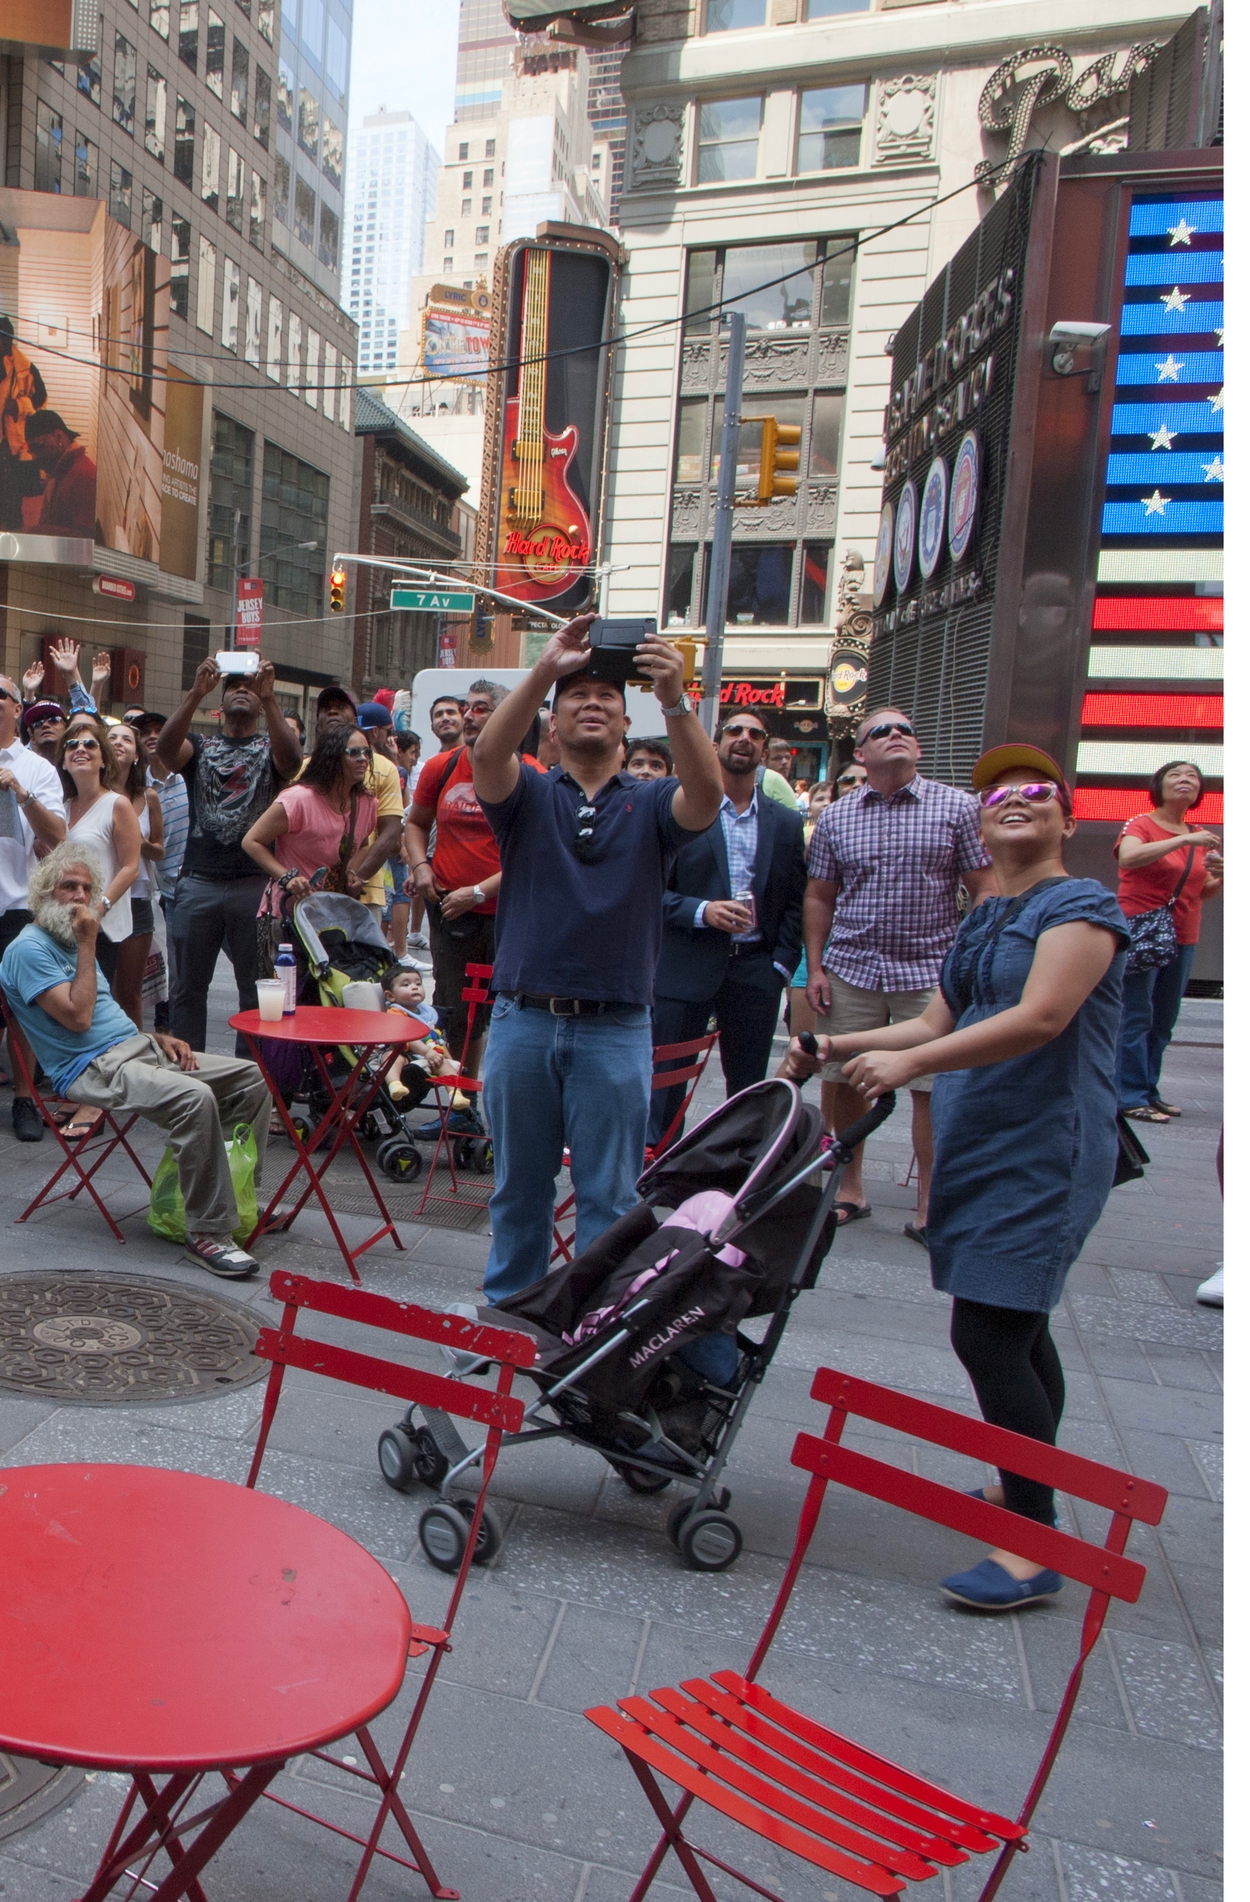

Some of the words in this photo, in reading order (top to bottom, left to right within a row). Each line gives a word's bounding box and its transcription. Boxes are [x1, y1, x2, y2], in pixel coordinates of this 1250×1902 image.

[444, 291, 467, 302] LYRIC
[466, 336, 490, 354] TOW
[504, 532, 550, 557] Hard
[550, 535, 590, 565] Rock
[237, 597, 263, 612] JERSEY
[417, 595, 426, 606] 7
[430, 595, 450, 608] Av
[241, 611, 260, 624] BOYS
[843, 667, 867, 682] Rock
[734, 682, 784, 707] Rock
[629, 1306, 706, 1369] MACLAREN
